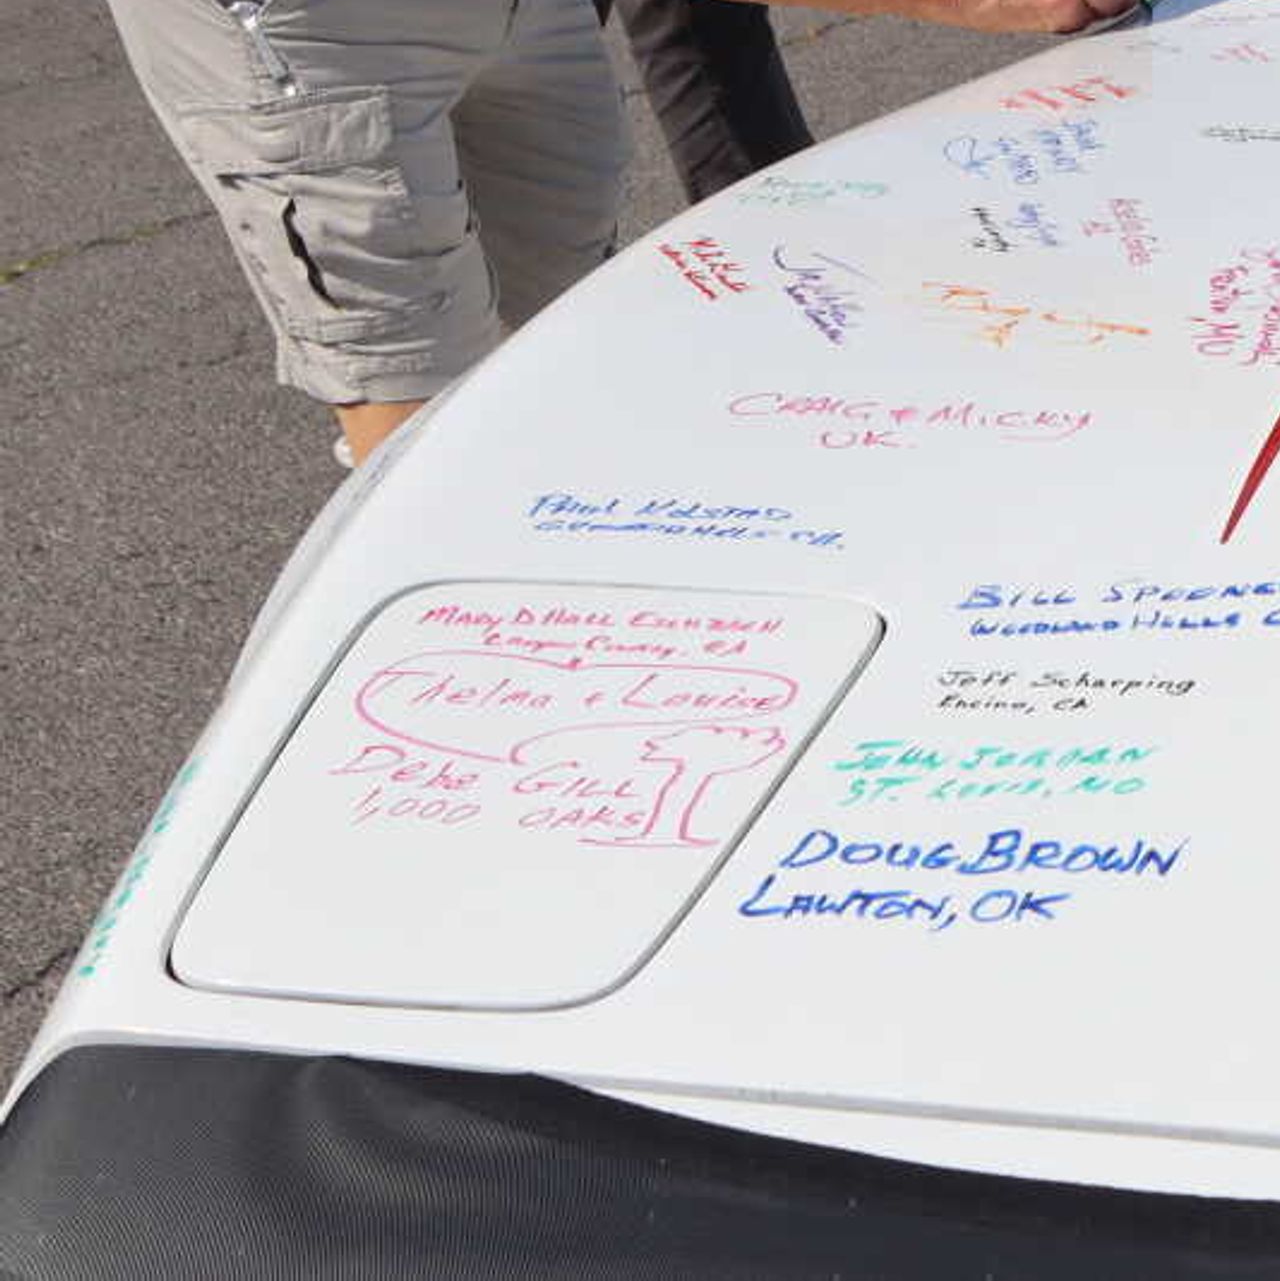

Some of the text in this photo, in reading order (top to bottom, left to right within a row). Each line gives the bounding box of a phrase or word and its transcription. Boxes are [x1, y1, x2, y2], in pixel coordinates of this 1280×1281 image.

[958, 585, 1076, 610] BILL
[777, 828, 1190, 877] DOUG BROWN
[969, 890, 1071, 922] OK
